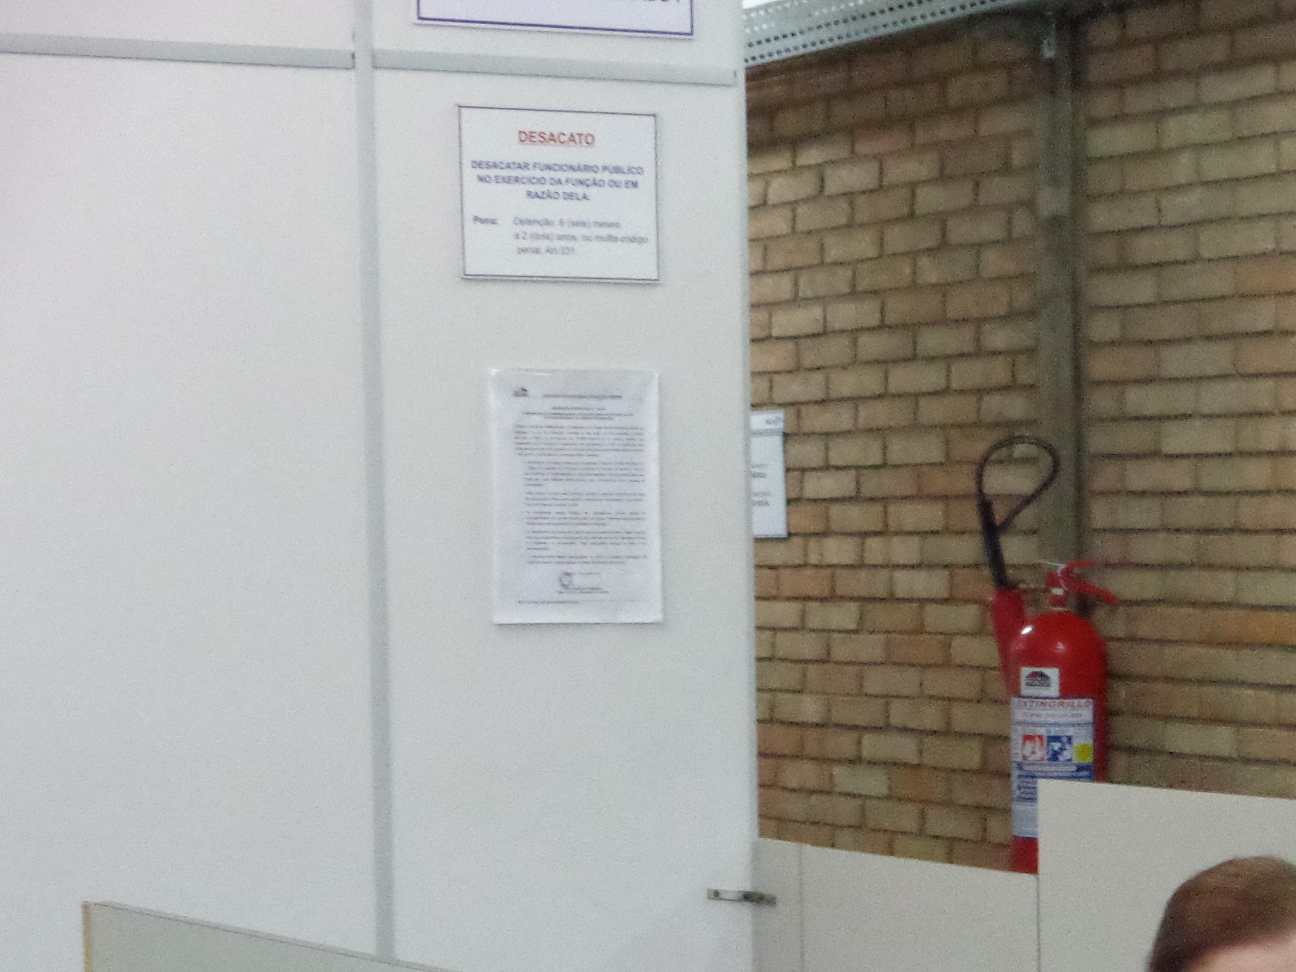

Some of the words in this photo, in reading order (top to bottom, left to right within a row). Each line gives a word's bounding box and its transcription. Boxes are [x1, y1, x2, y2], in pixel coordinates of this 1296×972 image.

[518, 130, 596, 146] DESACATO
[471, 160, 530, 171] DESACATAR
[532, 162, 599, 174] FUNCIONÁRIO
[477, 174, 492, 184] NO
[549, 176, 563, 186] DA
[565, 176, 606, 188] FUNÇÃO
[624, 180, 639, 189] EM
[526, 189, 560, 200] RAZÃO
